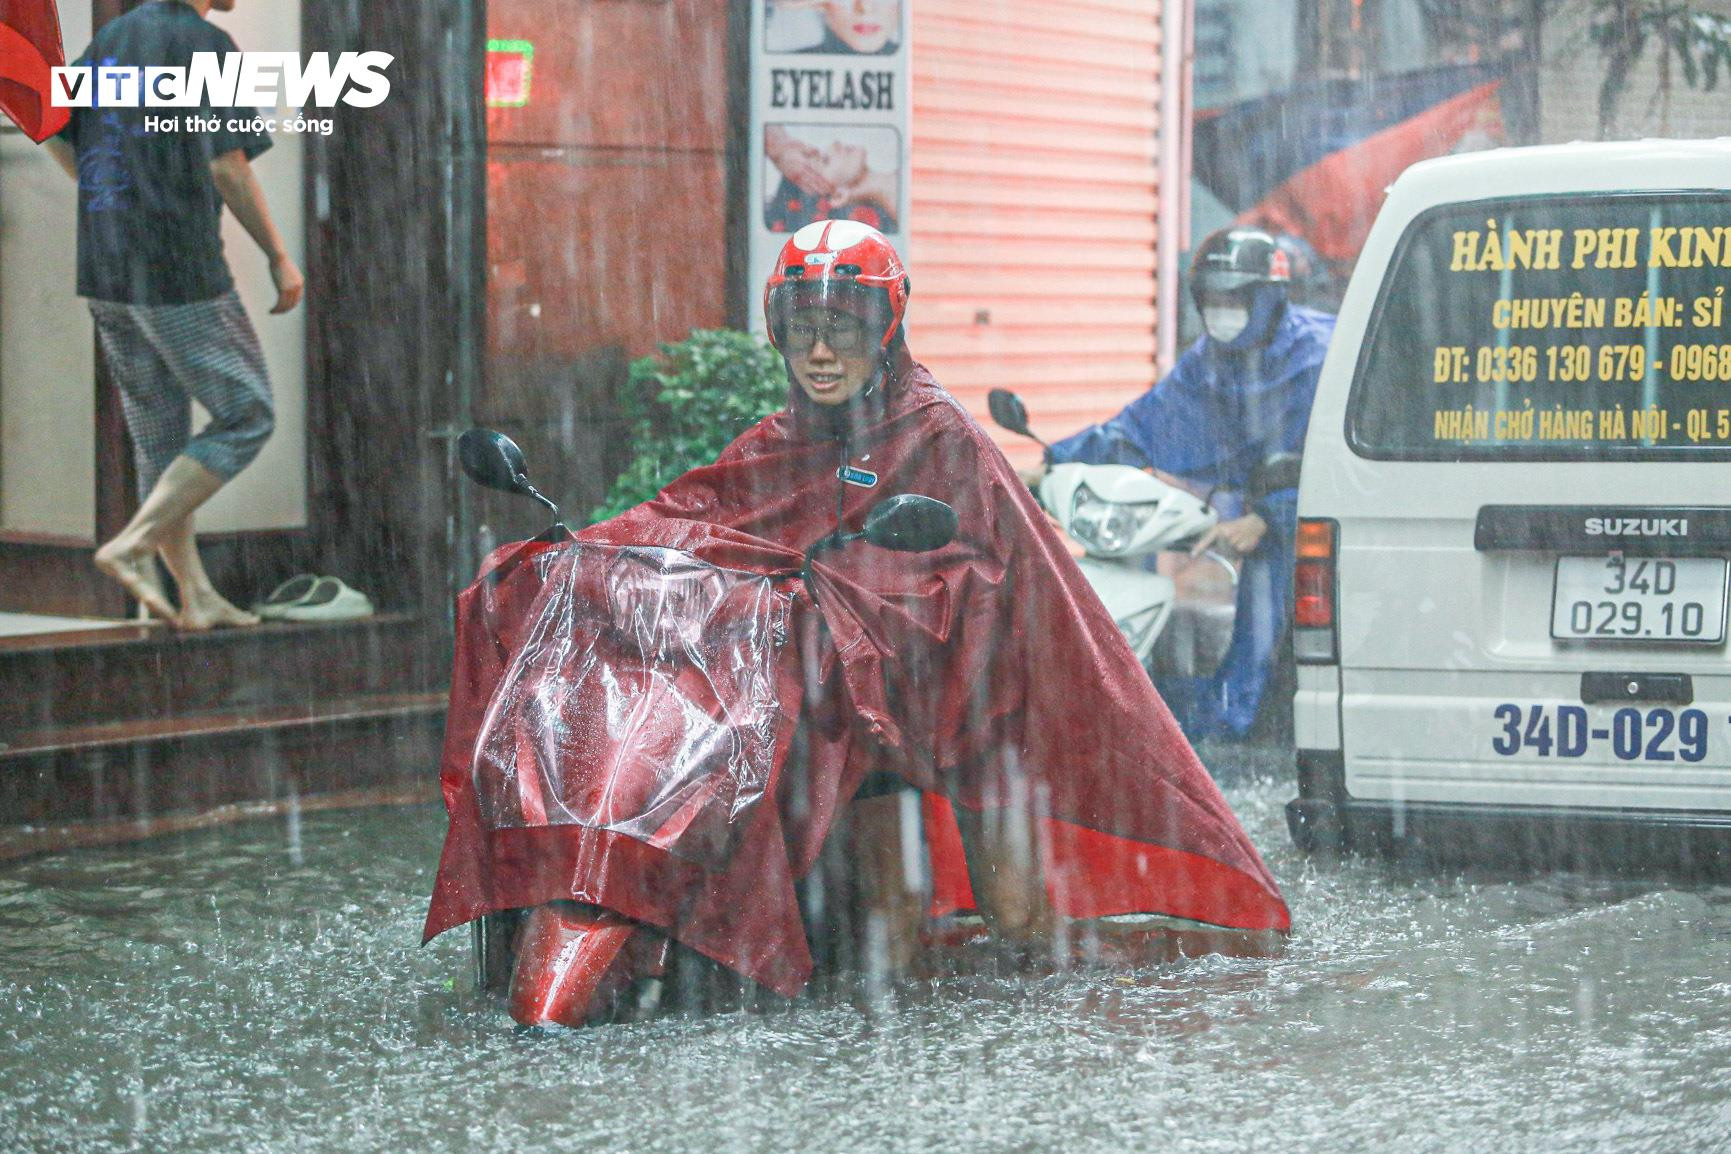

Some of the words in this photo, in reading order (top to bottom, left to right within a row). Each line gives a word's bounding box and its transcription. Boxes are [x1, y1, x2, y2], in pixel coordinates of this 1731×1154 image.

[771, 69, 895, 110] EYELASH
[1450, 219, 1563, 271] HÀNH
[1571, 228, 1640, 269] PHI
[1492, 292, 1605, 329] CHUYÊN
[1613, 291, 1683, 328] BÁN:
[1692, 286, 1725, 327] SỈ
[1434, 346, 1470, 383] ĐT:
[1476, 346, 1537, 382] 0336
[1546, 346, 1591, 381] 130
[1598, 345, 1645, 381] 679
[1670, 344, 1731, 380] 0968
[1434, 404, 1488, 445] NHẬN
[1494, 398, 1535, 440] CHỞ
[1539, 404, 1593, 440] HÀNG
[1599, 404, 1626, 440] HÀ
[1632, 404, 1668, 444] NỘI
[1687, 409, 1711, 442] QL
[1717, 409, 1730, 439] 5
[1585, 518, 1688, 536] SUZUKI
[1604, 560, 1676, 595] 34D
[1571, 601, 1704, 636] 029.10
[1492, 704, 1708, 762] 34D-029
